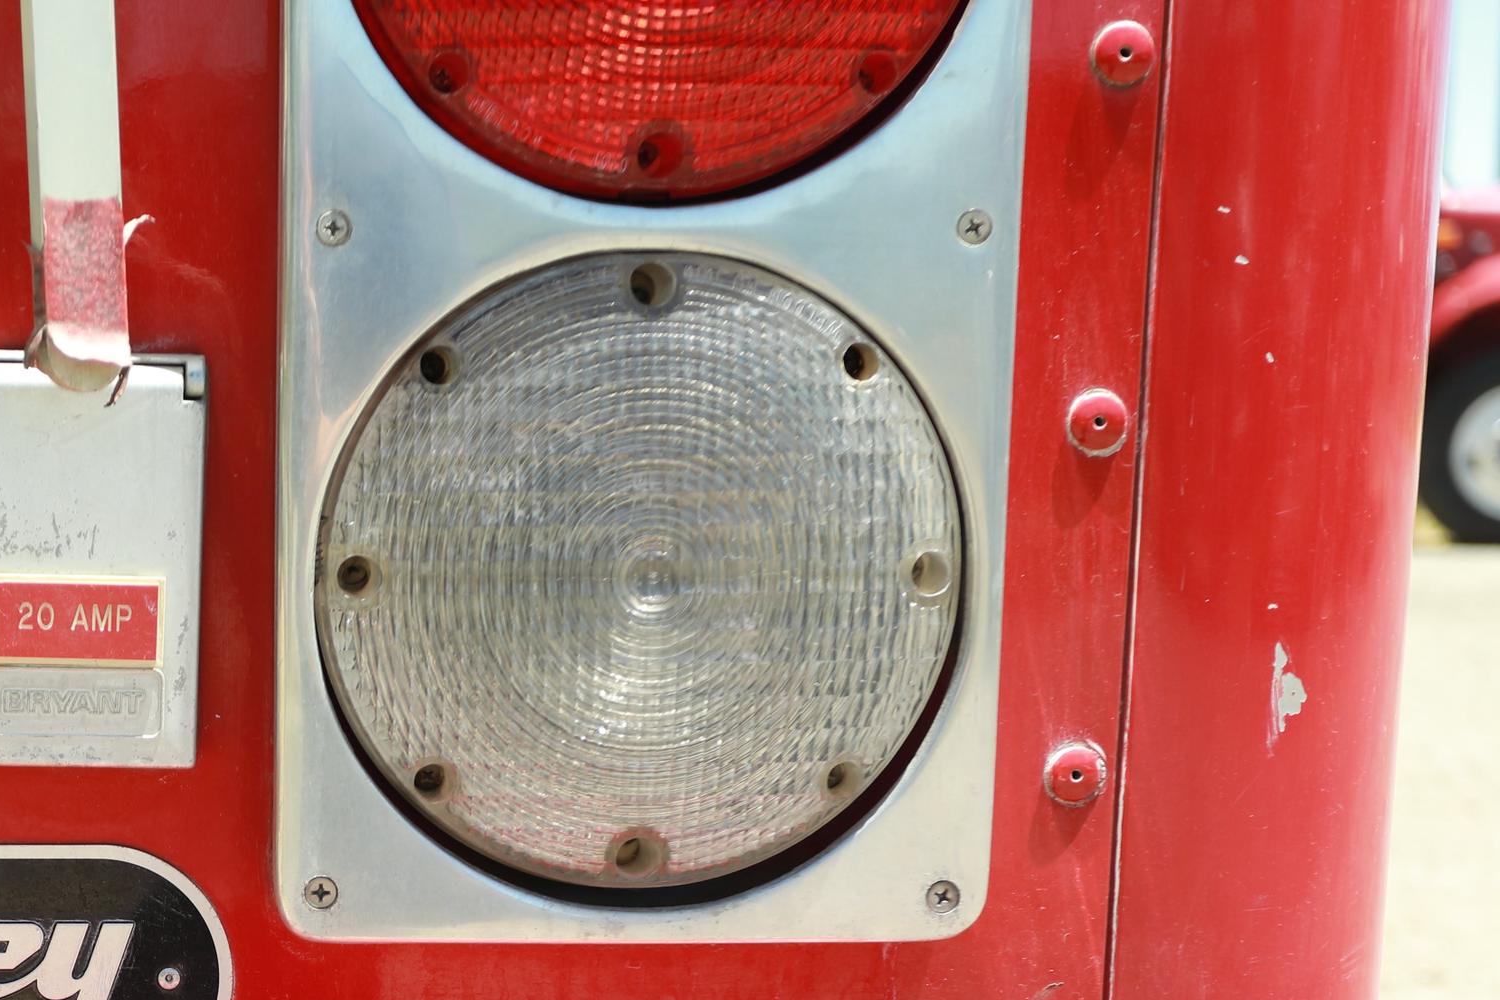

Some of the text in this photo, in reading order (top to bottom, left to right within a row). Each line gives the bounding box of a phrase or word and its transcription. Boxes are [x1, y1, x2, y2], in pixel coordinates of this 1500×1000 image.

[17, 601, 133, 632] 20 AMP
[2, 688, 146, 715] BRYANT
